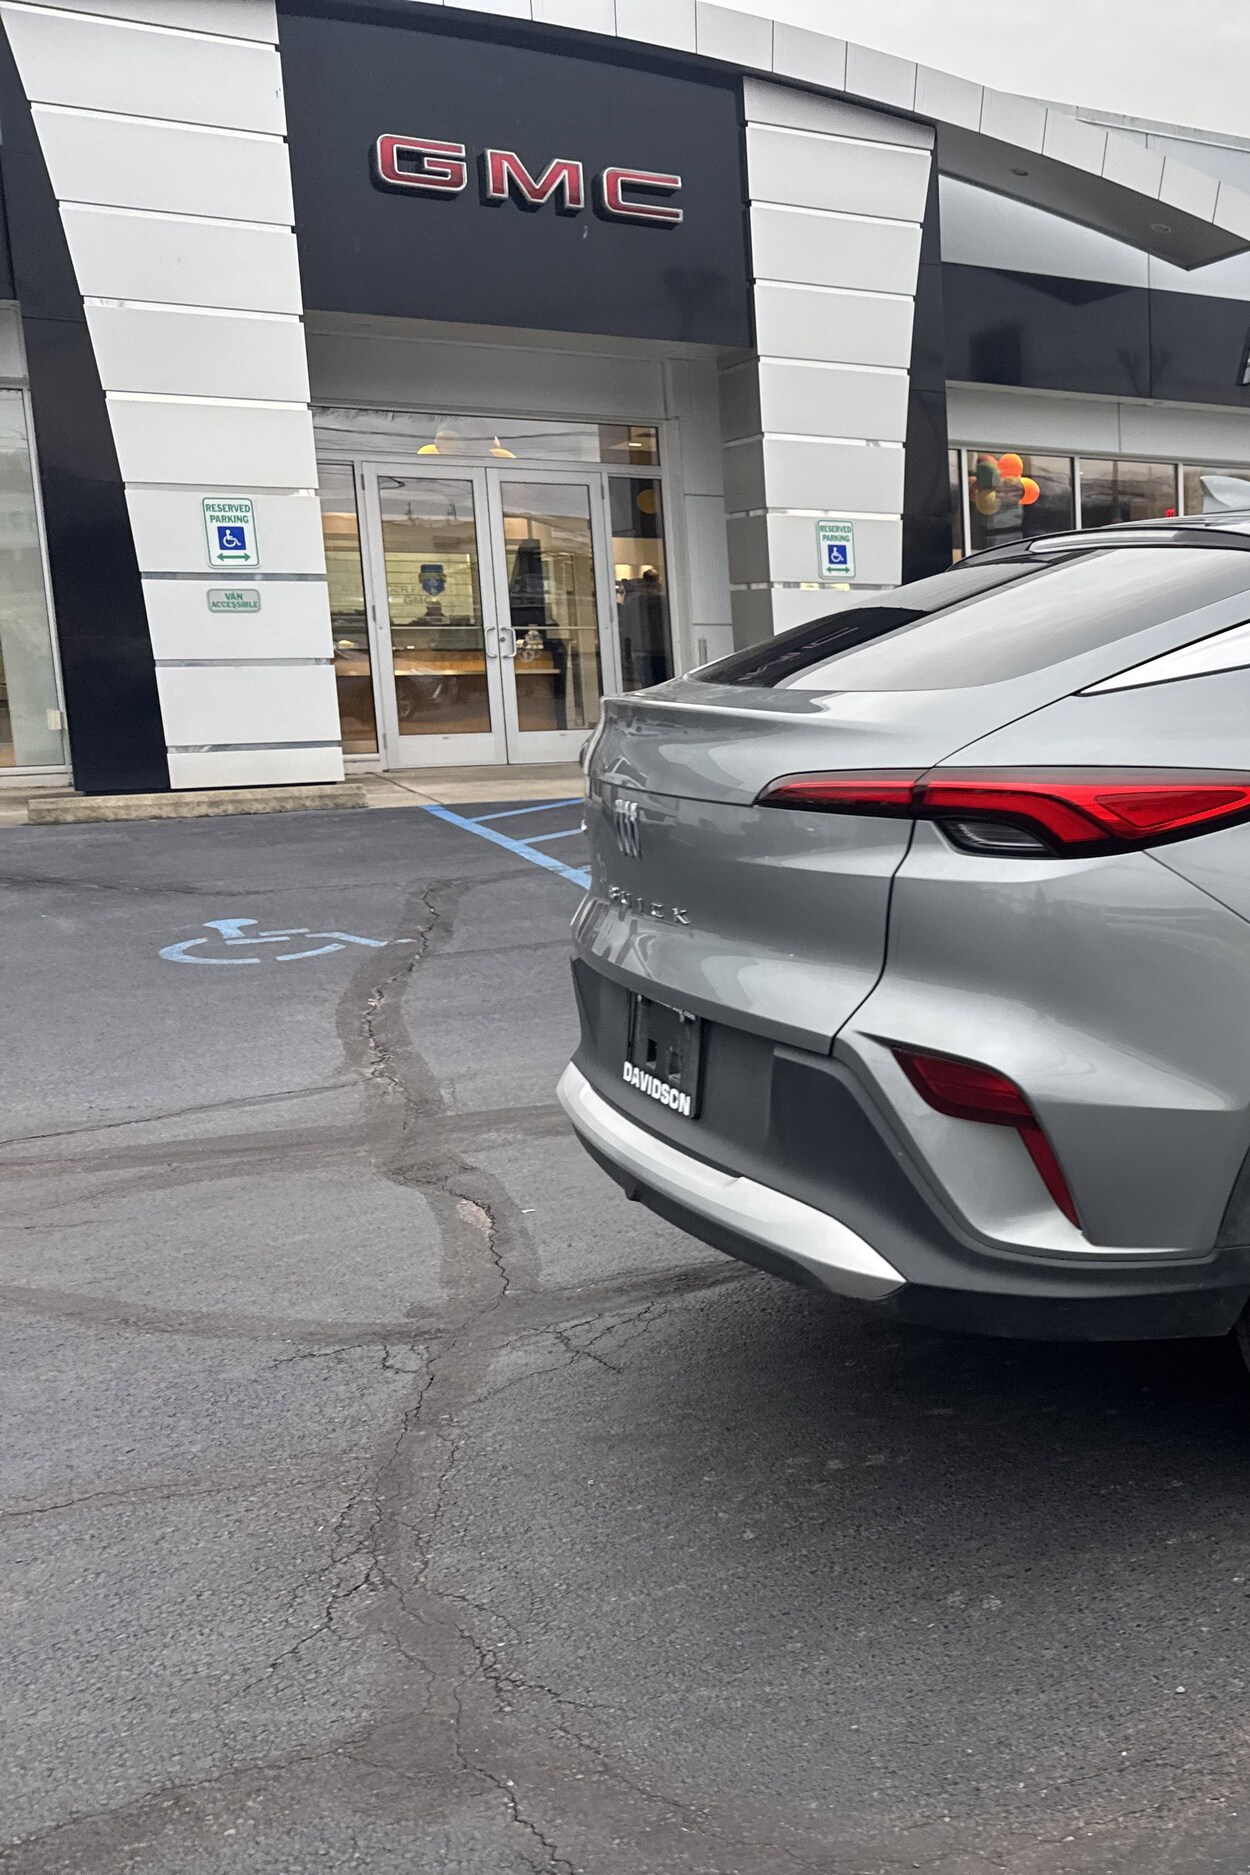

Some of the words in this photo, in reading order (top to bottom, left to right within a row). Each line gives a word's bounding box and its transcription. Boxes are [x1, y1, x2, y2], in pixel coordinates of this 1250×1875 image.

[374, 133, 683, 222] GMC
[205, 503, 251, 513] RESERVED
[209, 514, 249, 523] PARKING
[820, 525, 851, 533] RESERVED
[822, 534, 850, 542] PARKING
[224, 592, 243, 600] VAN
[211, 601, 258, 609] ACCESSIBLE
[622, 1061, 692, 1117] DAVIDSON
